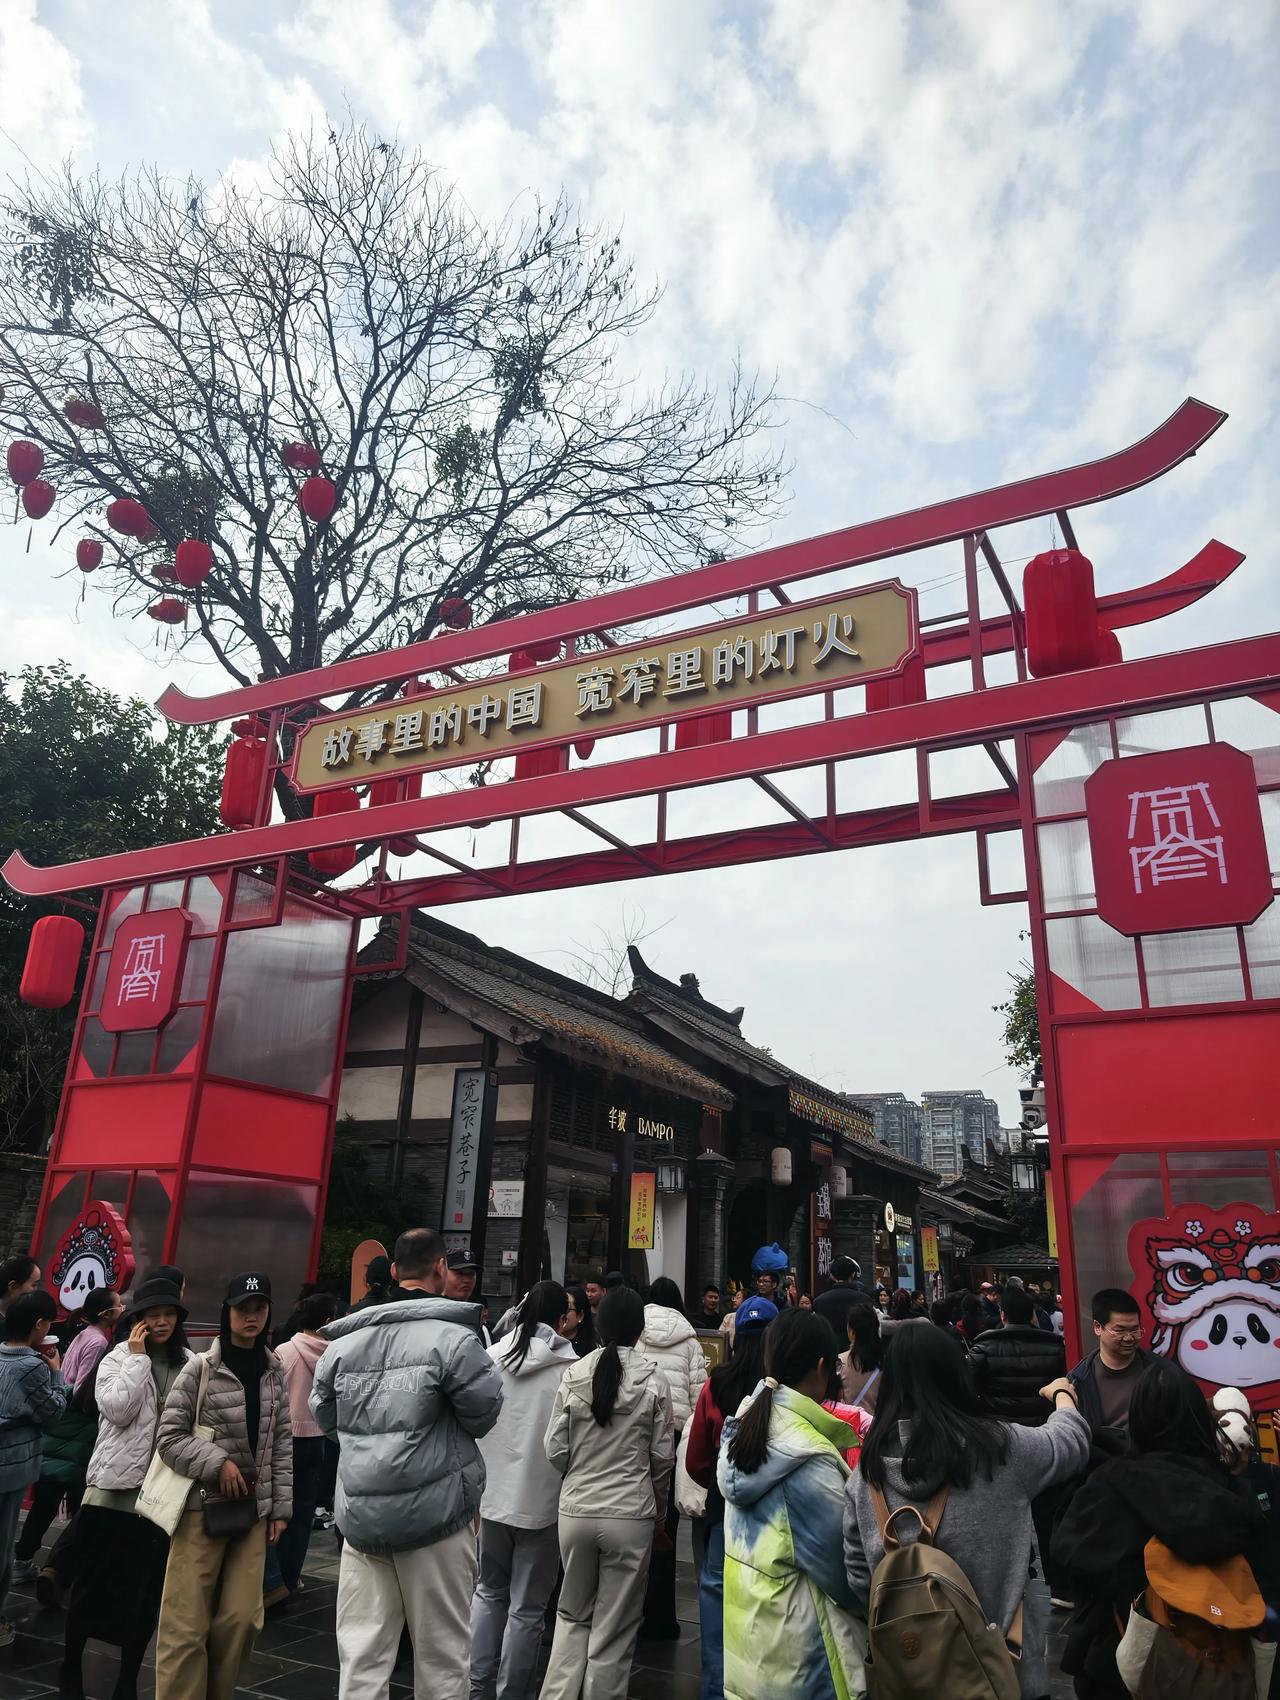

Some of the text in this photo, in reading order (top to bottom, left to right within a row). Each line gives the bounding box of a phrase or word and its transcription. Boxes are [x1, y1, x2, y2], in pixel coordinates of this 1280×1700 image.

[320, 613, 860, 769] 故事里的中国 宽窄里的灯火
[455, 1077, 479, 1184] 宽窄巷子
[638, 1117, 674, 1141] BAMPO
